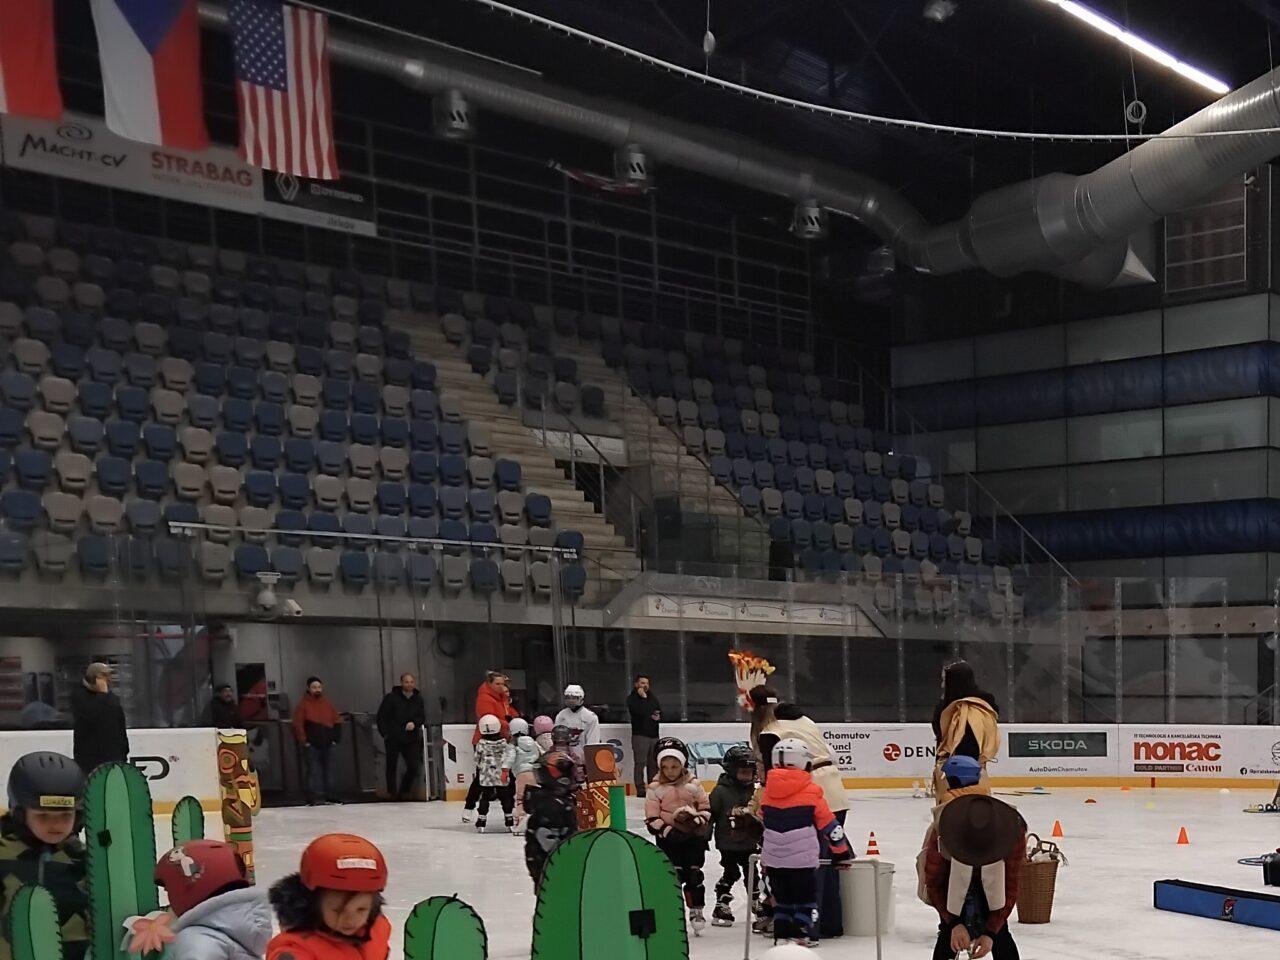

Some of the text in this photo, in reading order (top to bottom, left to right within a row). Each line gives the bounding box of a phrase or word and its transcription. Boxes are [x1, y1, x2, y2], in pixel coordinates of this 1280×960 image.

[151, 151, 253, 188] STRABAG
[822, 731, 871, 740] Chomutov
[828, 741, 852, 752] uncl
[1133, 741, 1222, 761] nonac
[1135, 764, 1154, 772] GOLD
[1185, 763, 1222, 772] Canon
